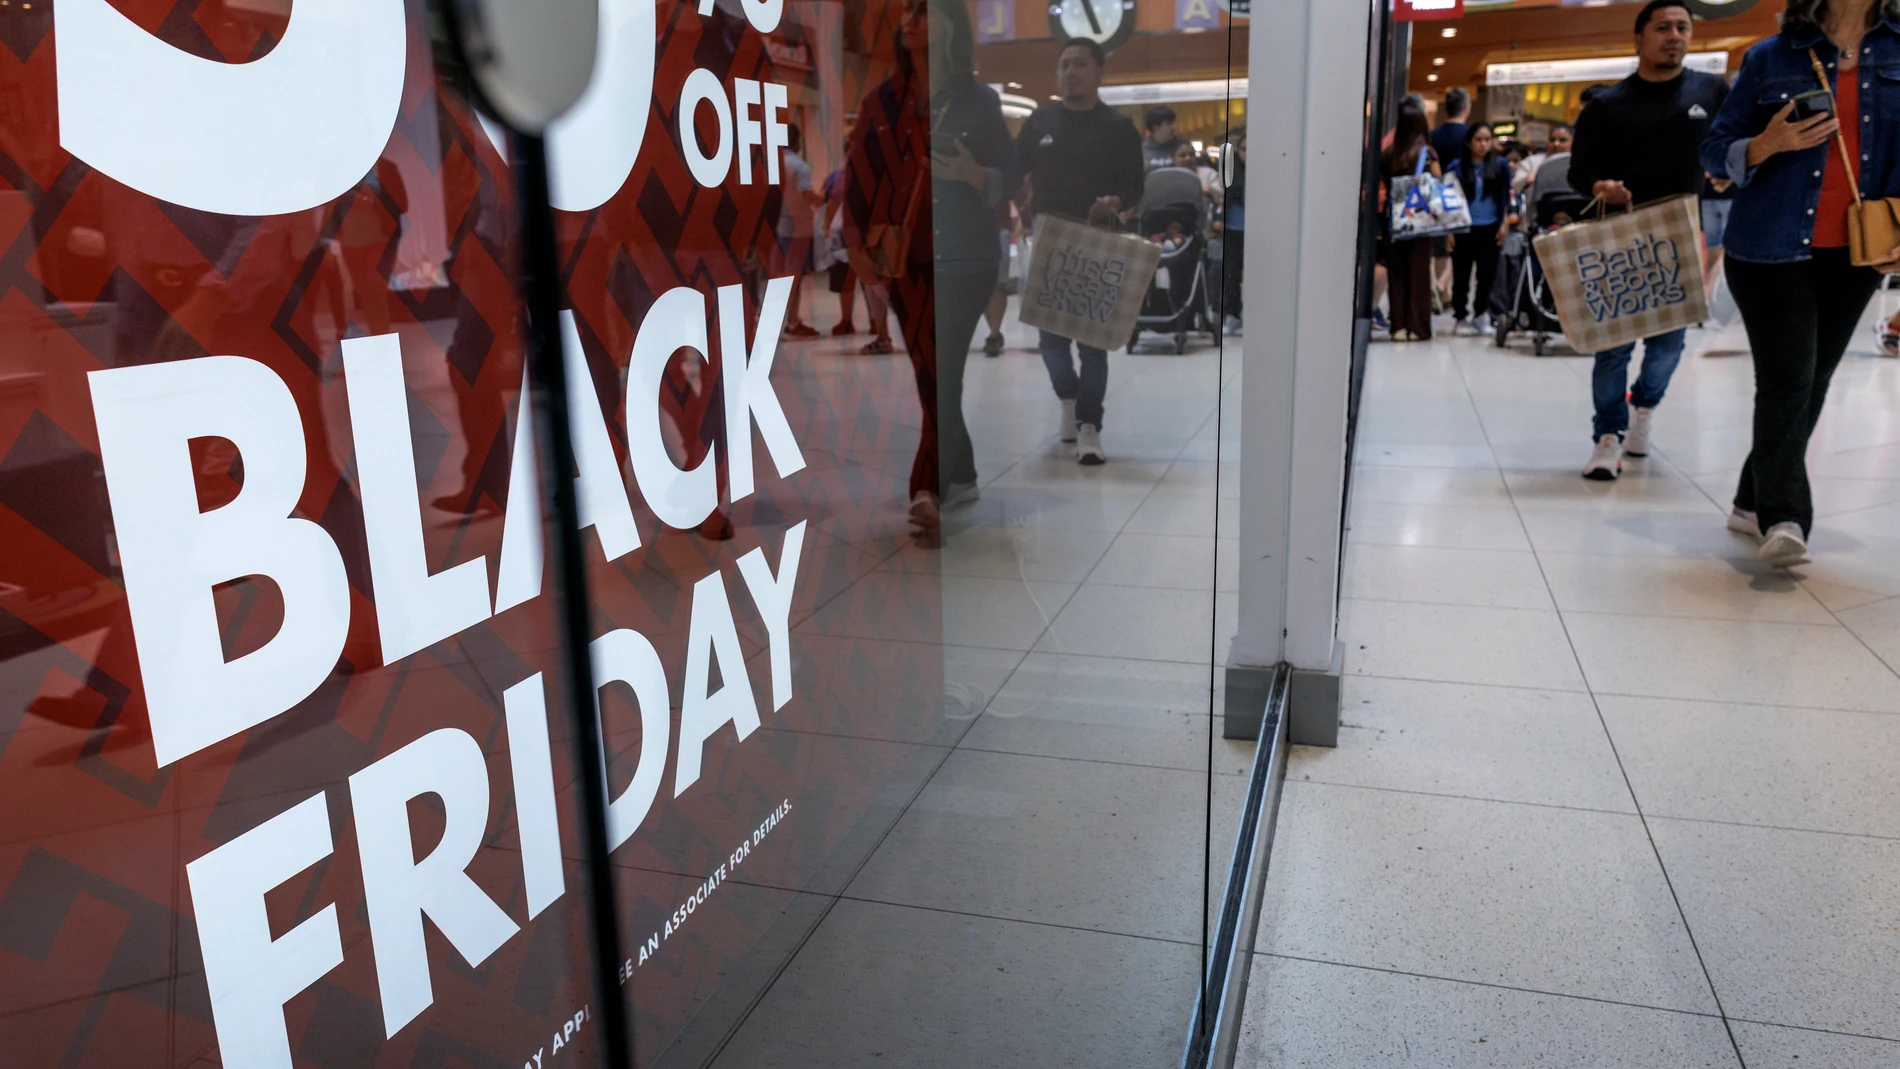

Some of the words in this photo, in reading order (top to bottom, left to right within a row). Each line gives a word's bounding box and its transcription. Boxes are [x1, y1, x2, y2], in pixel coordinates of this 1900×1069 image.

[679, 68, 788, 188] OFF
[1576, 234, 1678, 282] Bath
[1583, 280, 1601, 300] &
[1607, 262, 1680, 295] Body
[1586, 284, 1686, 322] Works
[87, 276, 806, 769] BLACK
[186, 519, 807, 1069] FRIDAY
[552, 1003, 592, 1056] APPL
[618, 958, 633, 986] EE
[638, 932, 660, 966] AN
[664, 863, 727, 940] ASSOCIATE
[729, 839, 751, 872] FOR
[753, 798, 793, 847] DETAILS.
